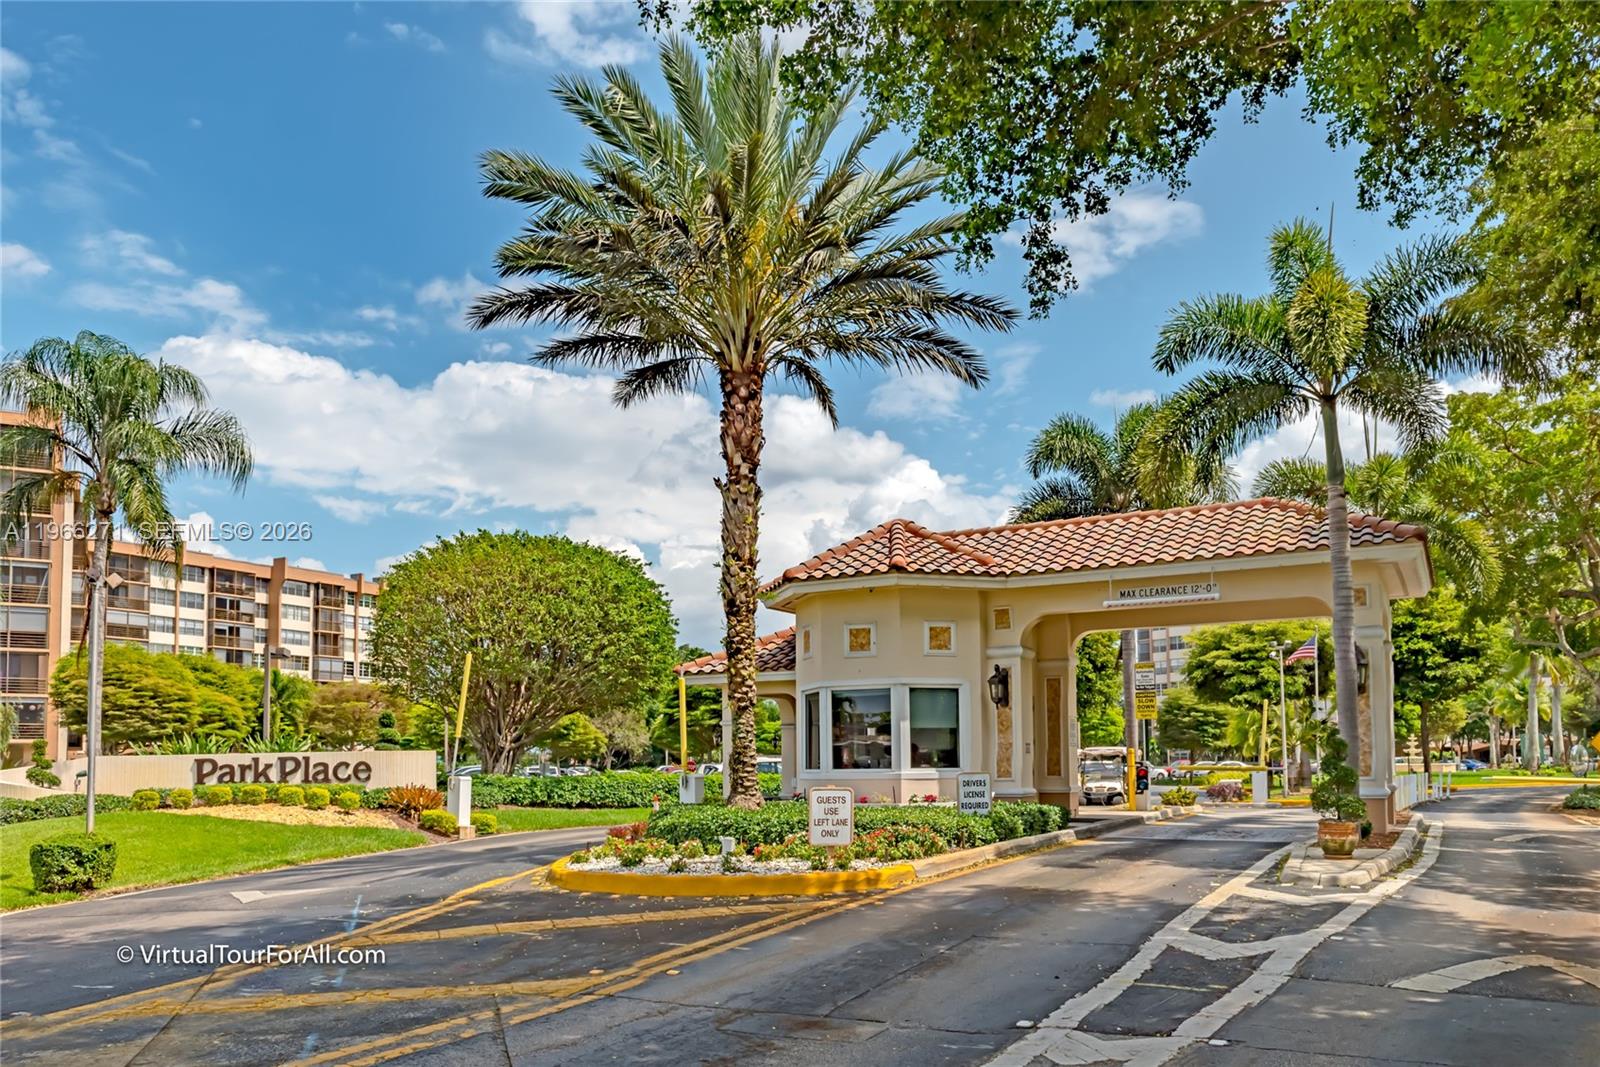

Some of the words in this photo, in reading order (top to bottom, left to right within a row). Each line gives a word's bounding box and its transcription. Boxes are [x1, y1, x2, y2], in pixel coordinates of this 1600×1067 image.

[1119, 590, 1137, 599] MAX
[1139, 585, 1188, 598] CLEARANCE
[962, 779, 987, 788] DRIVERS
[963, 790, 986, 799] LICENSE
[816, 796, 846, 805] GUESTS
[960, 801, 990, 810] REQUIRED
[823, 807, 839, 816] USE
[813, 818, 829, 827] LEFT
[831, 818, 848, 827] LANE
[820, 829, 840, 838] ONLY
